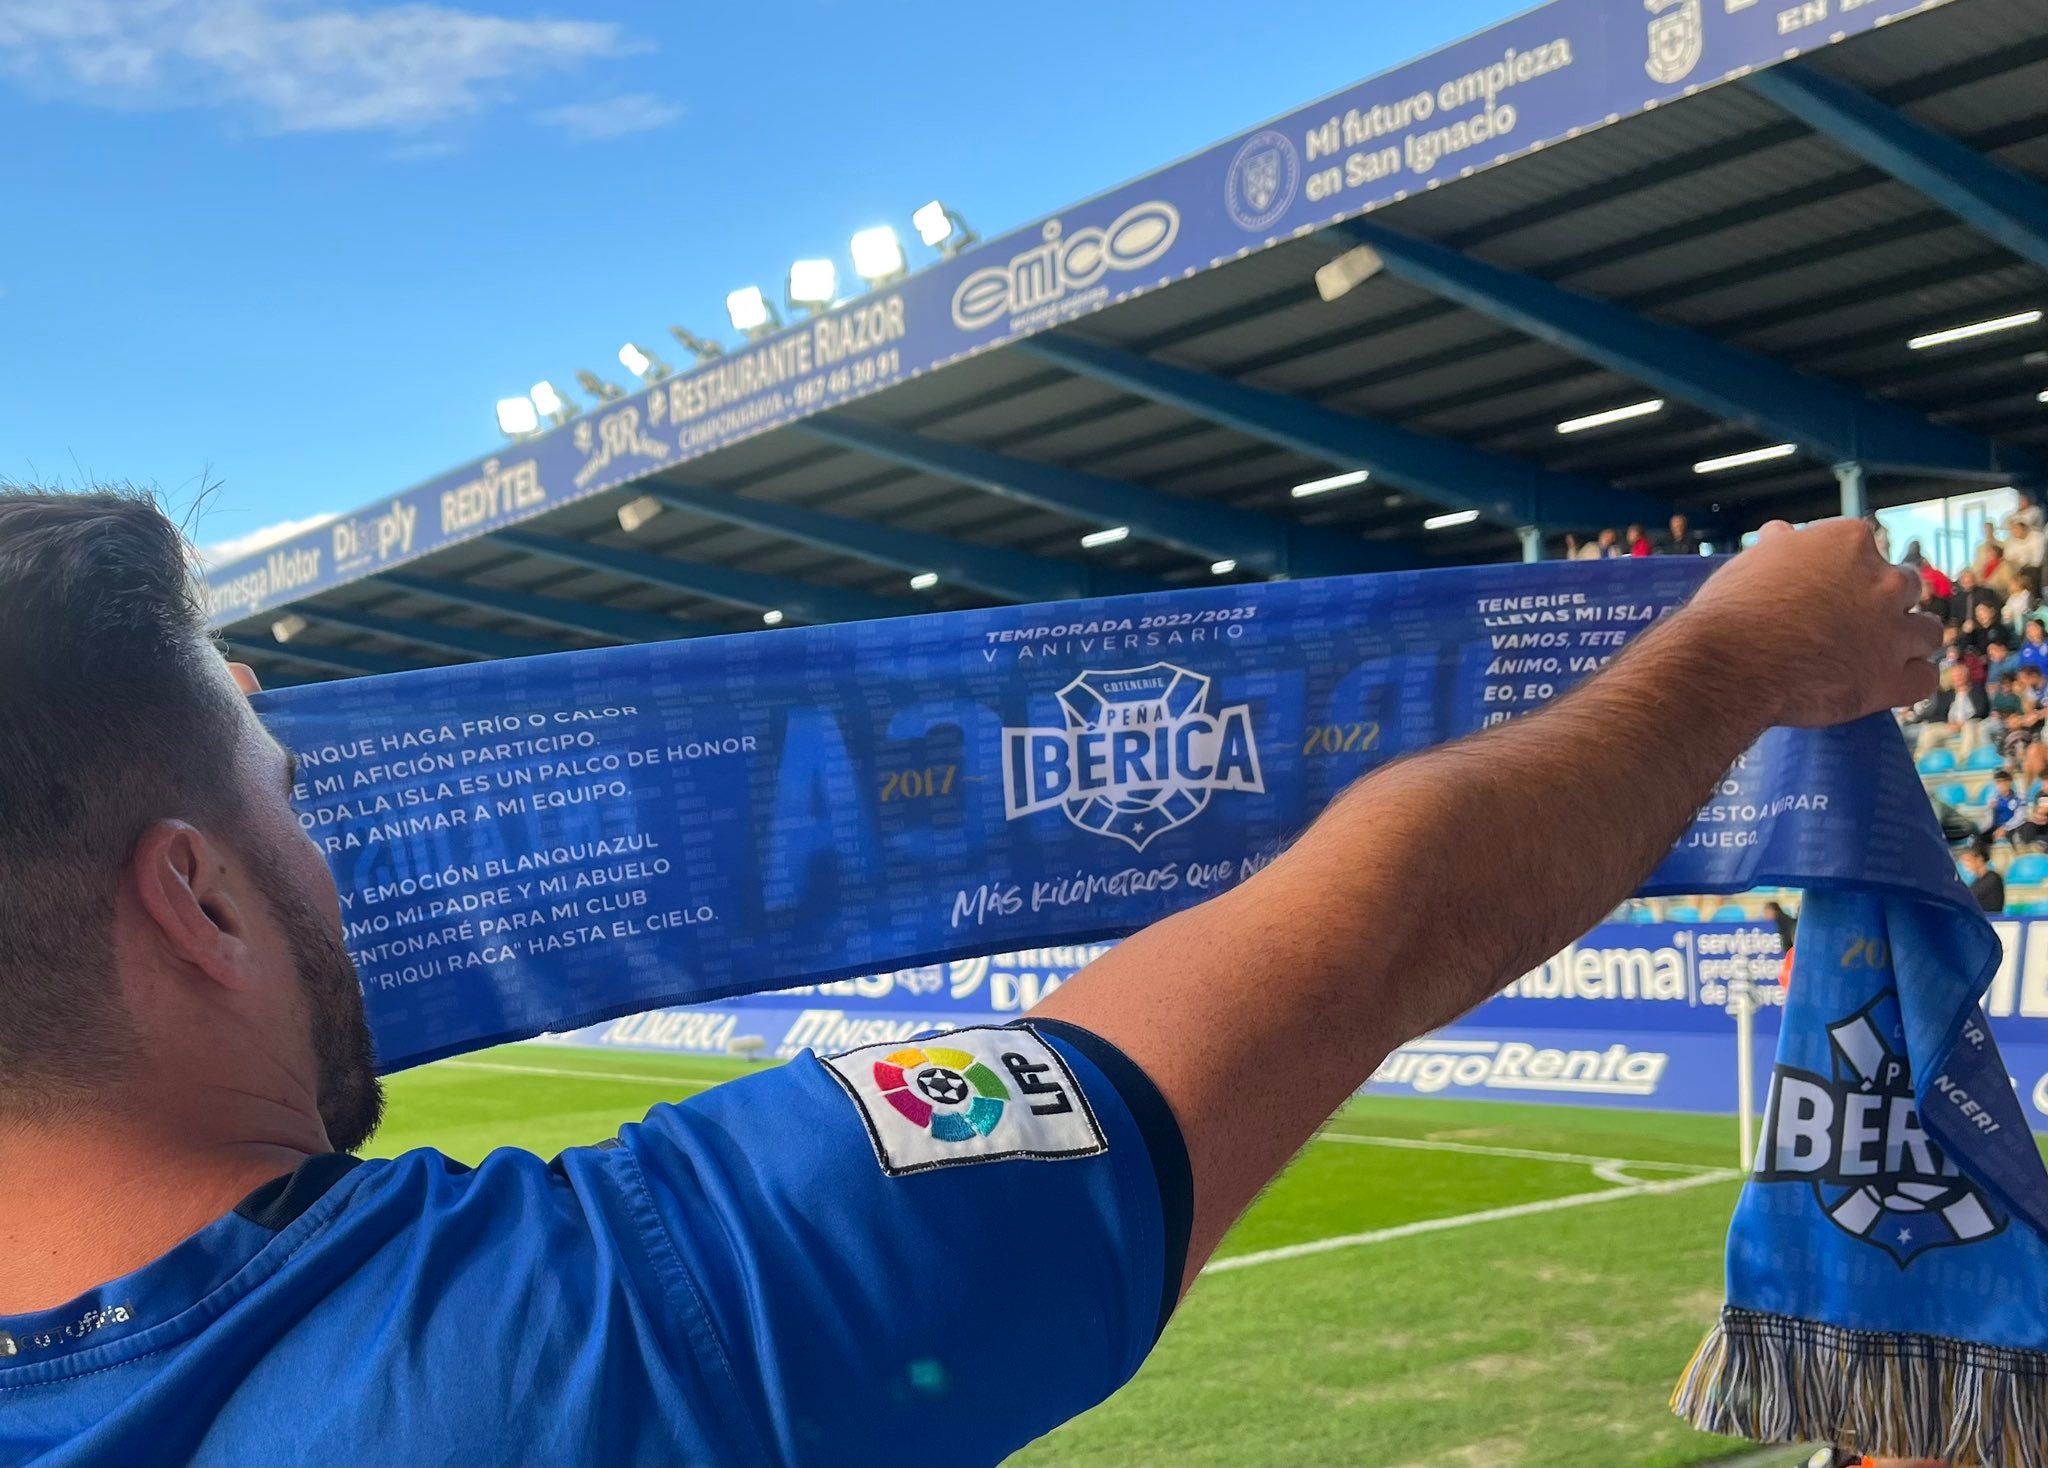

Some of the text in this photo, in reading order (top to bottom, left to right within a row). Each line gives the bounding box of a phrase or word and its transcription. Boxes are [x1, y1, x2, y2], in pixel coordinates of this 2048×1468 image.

[1305, 37, 1574, 162] Mi futuro empieza
[1304, 165, 1342, 202] en
[1345, 145, 1401, 188] San
[1404, 103, 1518, 175] Ignacio
[668, 294, 905, 425] RESTAURANTE RIAZOR
[268, 547, 321, 593] Motor
[985, 605, 1257, 644] TEMPORADA 2022/2023
[1477, 593, 1586, 614] TENERIFE
[1484, 609, 1570, 627] LLEVAS
[1575, 607, 1602, 622] MI
[1606, 605, 1653, 621] ISLA
[982, 624, 1243, 663] V ANIVERSARIO
[1490, 630, 1627, 650] VAMOS, TETE
[1484, 656, 1562, 676] ÁNIMO,
[1107, 704, 1162, 727] PEÑA
[1483, 684, 1518, 703] EO,
[301, 706, 638, 769] NQUE HAGA FRÍO O CALOR
[290, 731, 600, 801] E MI AFICIÓN PARTICIPO.
[299, 736, 757, 829] ODA LA ISLA ES UN PALCO DE HONOR
[881, 765, 957, 802] 2017
[368, 809, 467, 844] ANIMAR
[474, 805, 491, 821] A
[497, 797, 525, 816] MI
[532, 781, 632, 810] EQUIPO.
[1692, 805, 1756, 822] ESTO
[1688, 830, 1758, 848] JUEGO.
[363, 865, 479, 905] EMOCIÓN
[485, 832, 659, 878] BLANQUIAZUL
[396, 905, 424, 926] MI
[430, 888, 511, 918] PADRE
[517, 882, 532, 899] Y
[539, 876, 568, 895] MI
[575, 858, 670, 889] ABUELO
[479, 910, 545, 937] PARA
[551, 902, 579, 922] MI
[585, 889, 648, 914] CLUB
[369, 959, 441, 991] "RIQUI
[448, 943, 521, 972] RACA"
[528, 925, 605, 955] HASTA
[612, 921, 641, 937] EL
[645, 905, 719, 932] CIELO.
[1840, 935, 1889, 970] 20
[1001, 1051, 1074, 1116] LFP
[1933, 1074, 2001, 1135] NCER!
